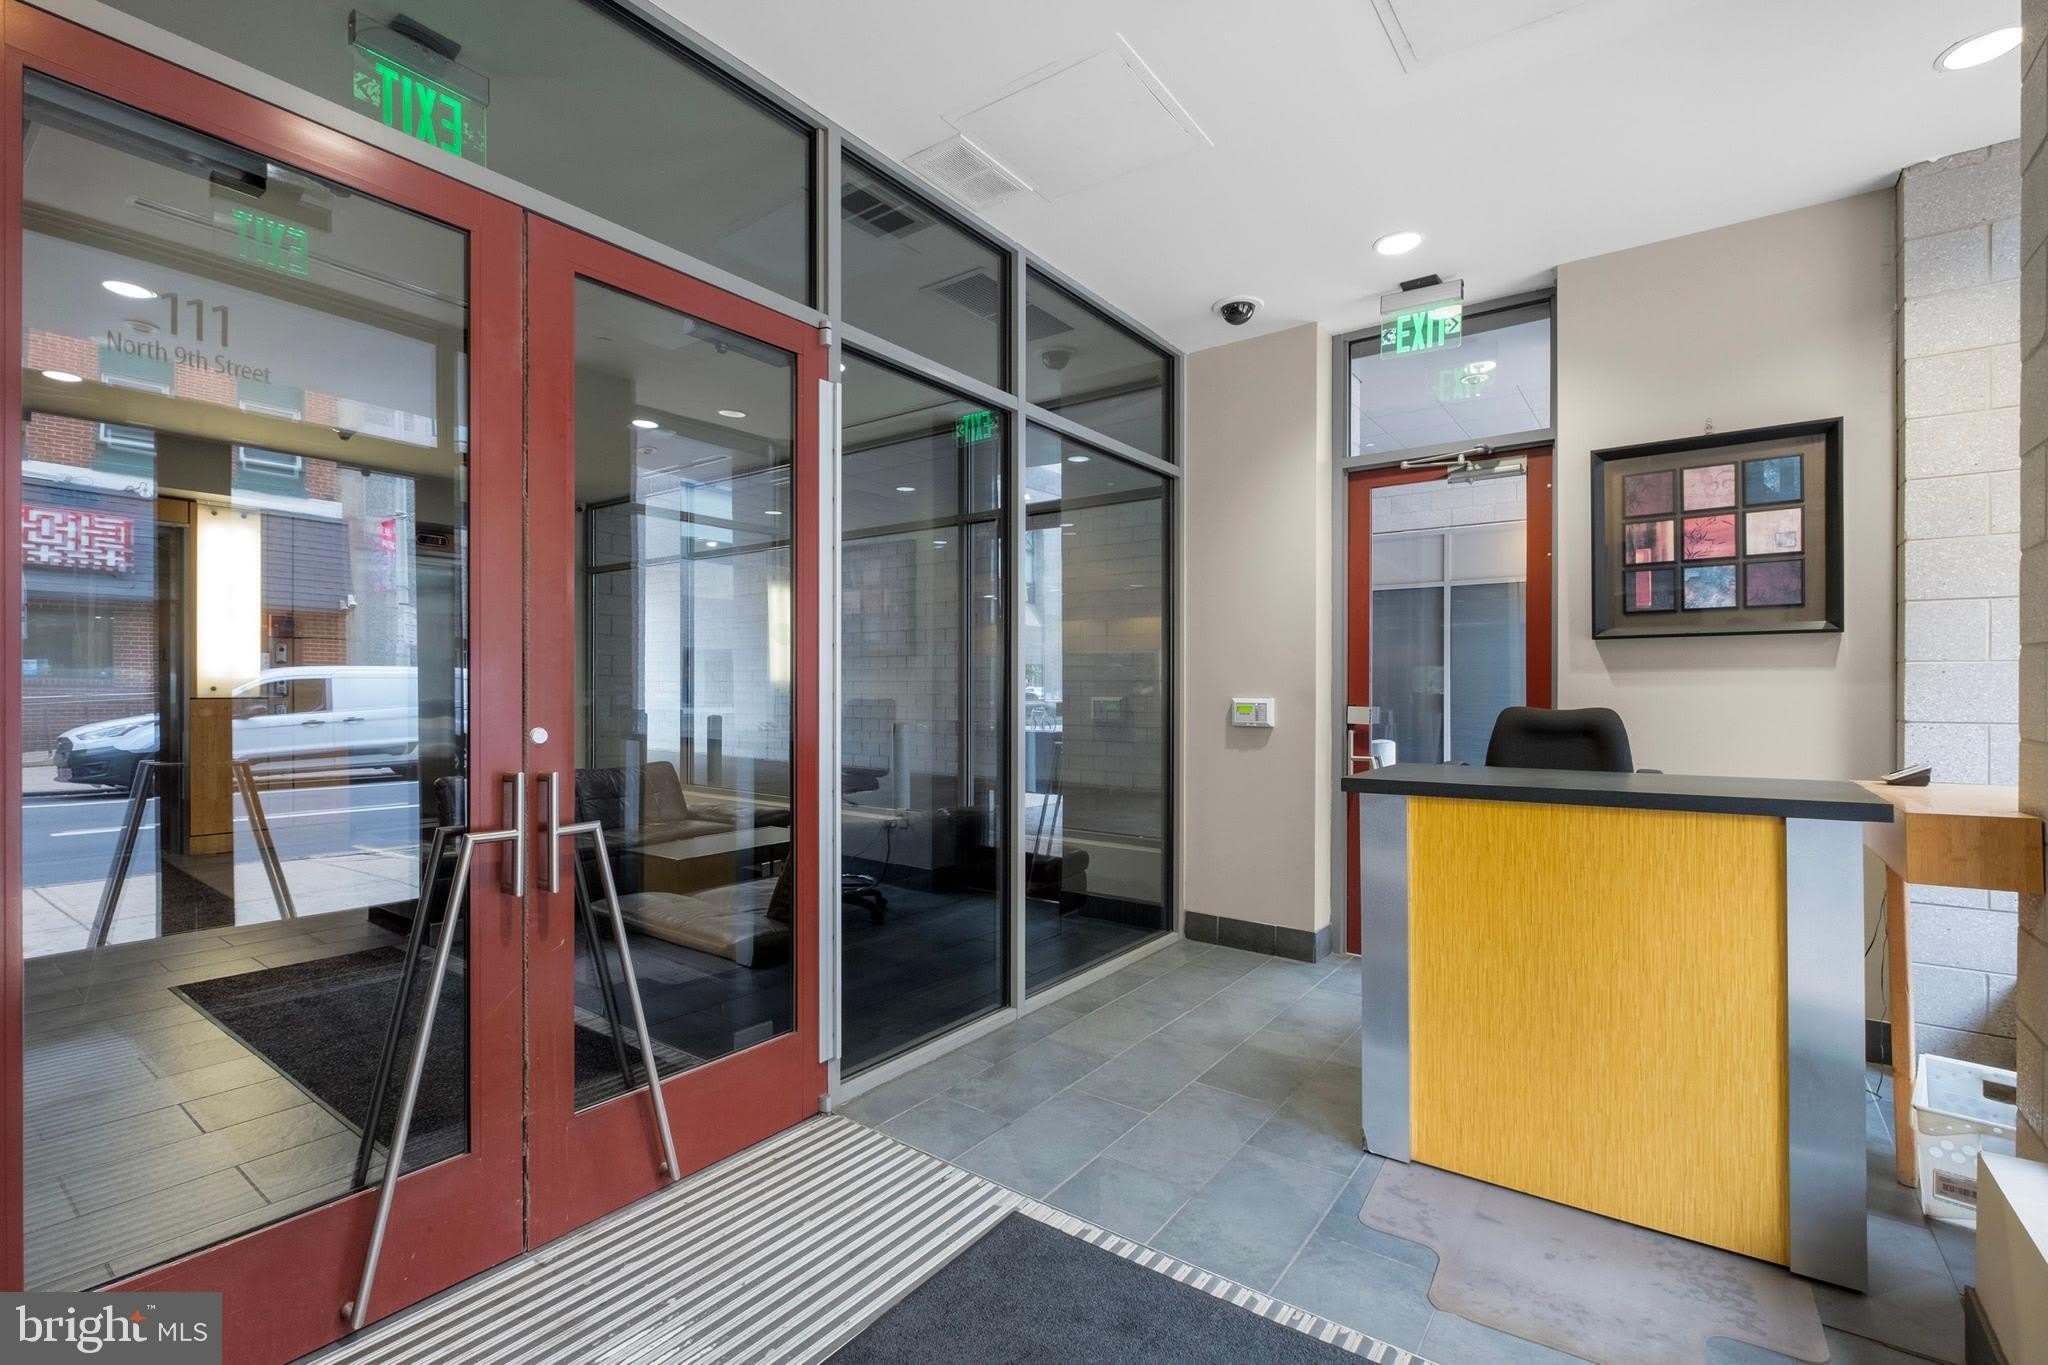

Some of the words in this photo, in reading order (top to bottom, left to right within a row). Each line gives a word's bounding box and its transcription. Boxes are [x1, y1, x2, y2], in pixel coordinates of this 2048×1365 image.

[160, 292, 229, 347] 111
[1397, 308, 1446, 353] EXIT
[106, 329, 168, 362] North
[175, 346, 208, 370] 9th
[215, 355, 273, 384] Street
